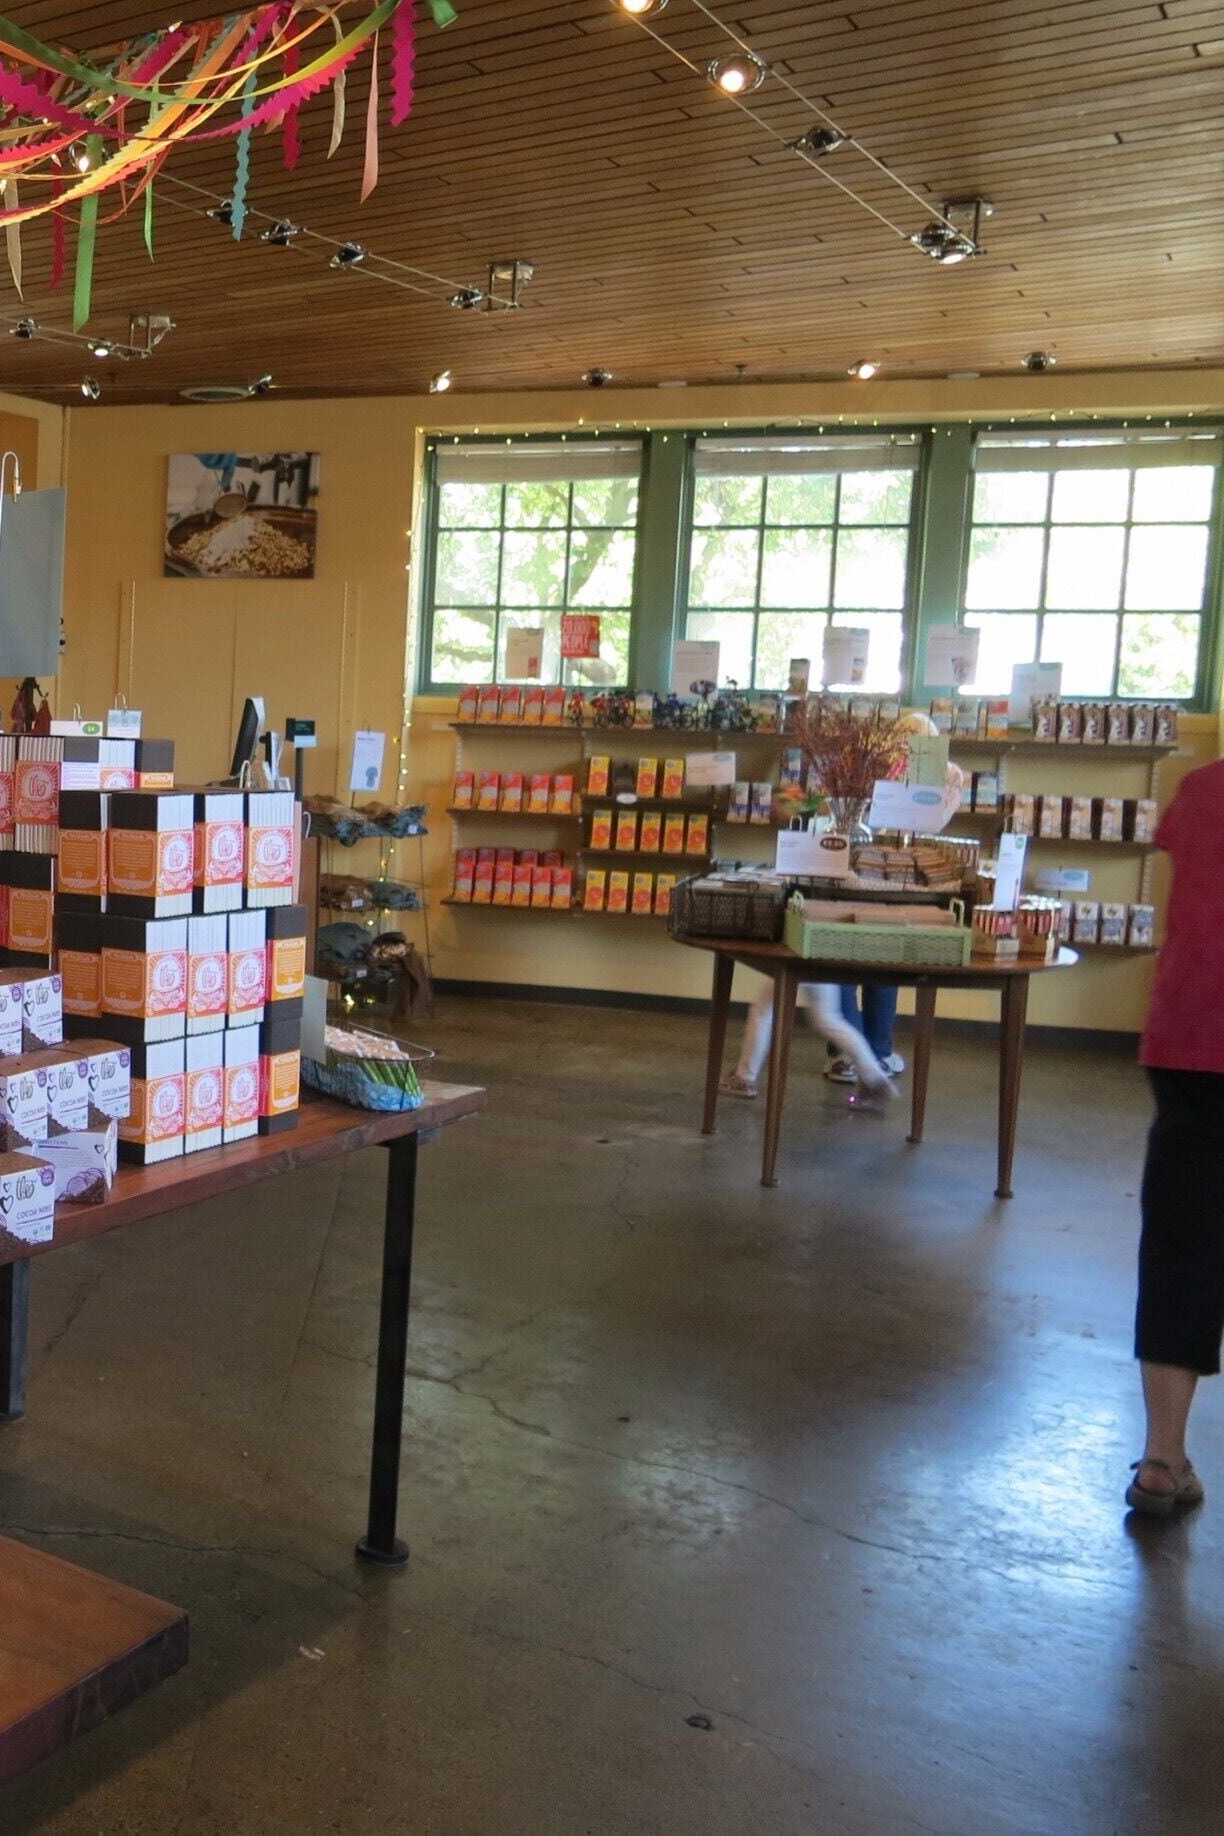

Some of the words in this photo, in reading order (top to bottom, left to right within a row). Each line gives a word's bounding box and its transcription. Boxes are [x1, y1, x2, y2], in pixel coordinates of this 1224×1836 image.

[16, 1175, 37, 1201] theo
[16, 1208, 37, 1220] COCOA
[38, 1204, 52, 1216] NIBS
